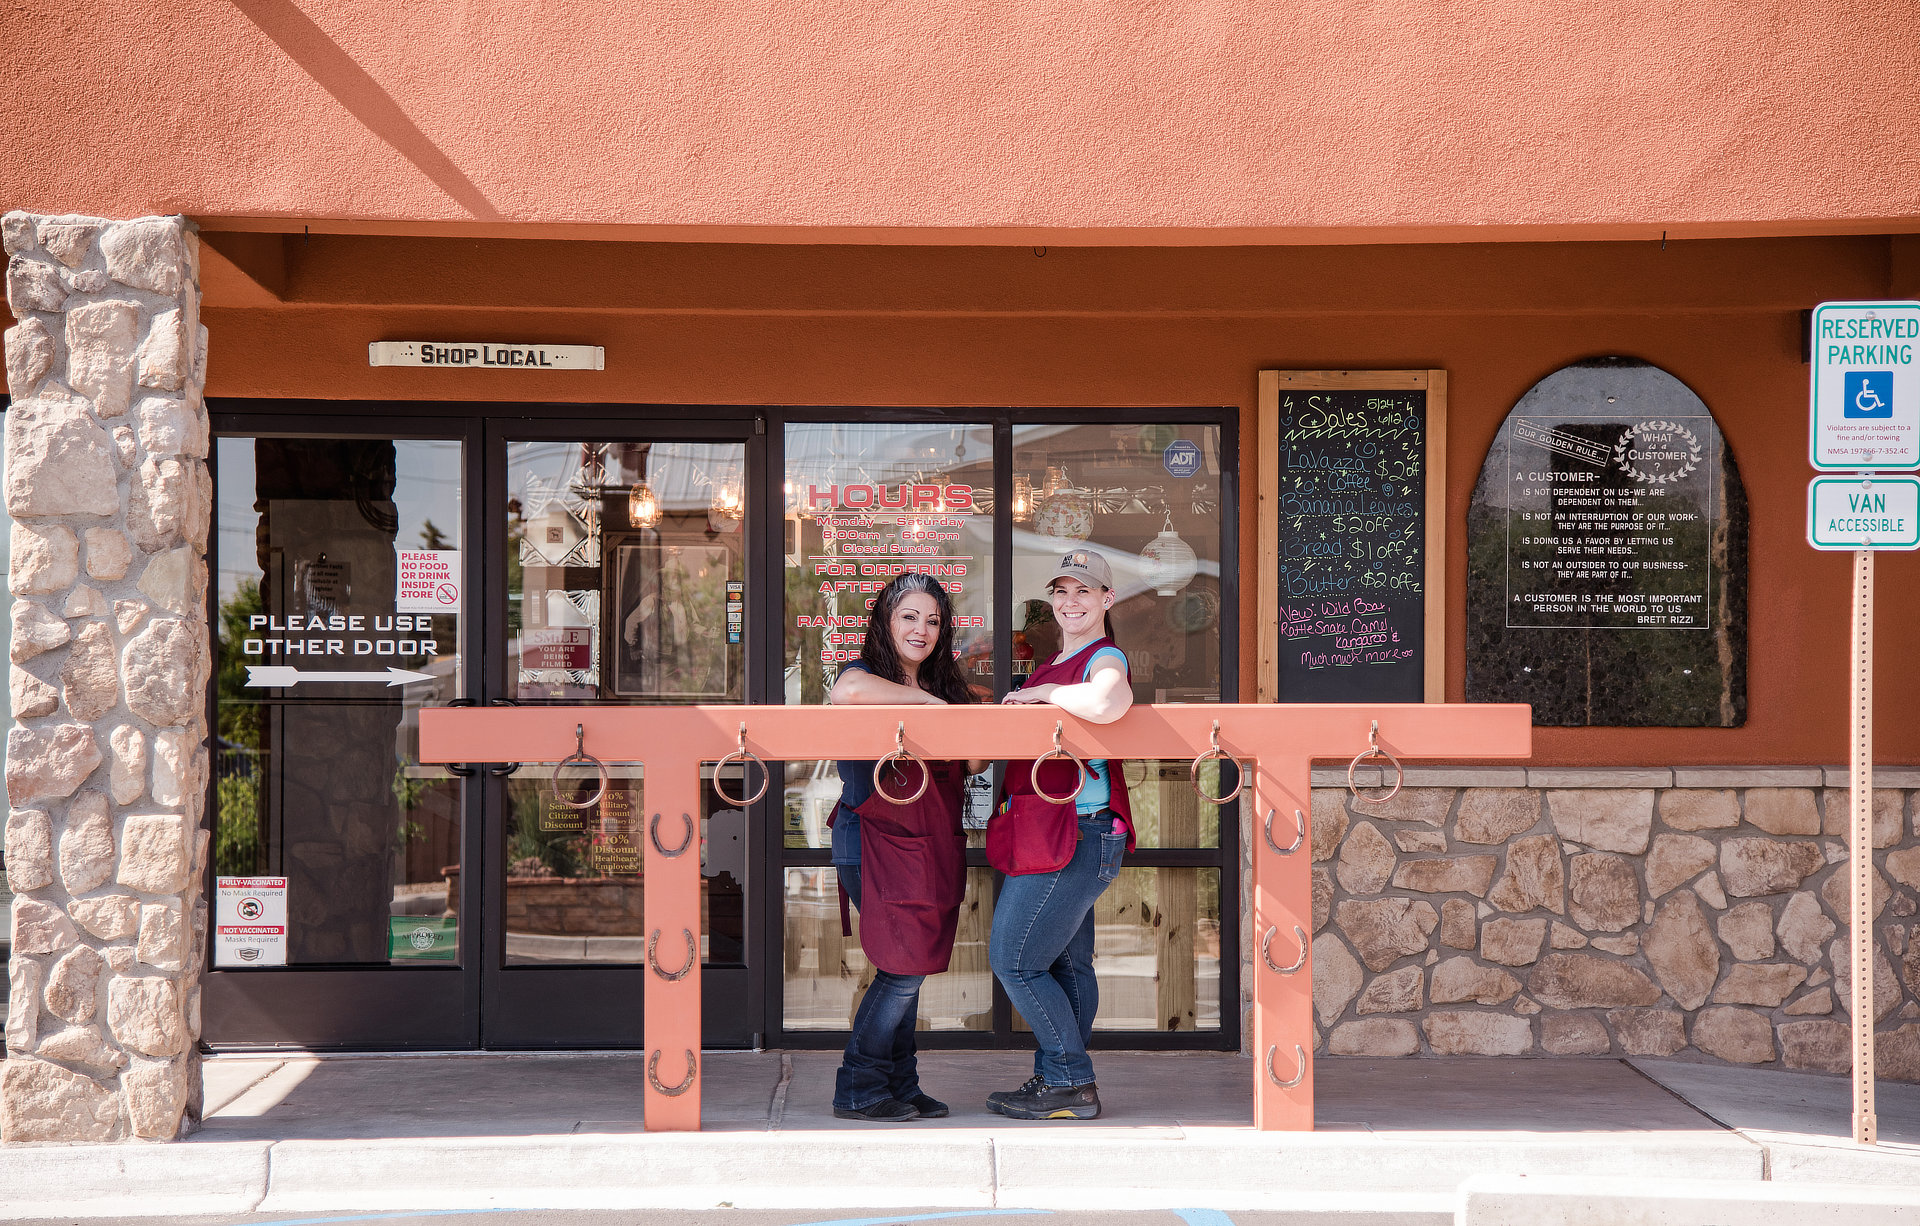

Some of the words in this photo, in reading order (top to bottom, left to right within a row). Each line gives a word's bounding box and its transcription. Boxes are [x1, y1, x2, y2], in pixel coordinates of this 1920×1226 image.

[1822, 318, 1919, 339] RESERVED
[421, 344, 479, 364] SHOP
[483, 345, 553, 366] LOCAL
[1828, 344, 1912, 365] PARKING
[1298, 395, 1368, 429] Sales
[1871, 424, 1896, 433] subject
[1517, 427, 1536, 439] OUR
[1539, 433, 1573, 451] GOLDEN
[1642, 433, 1673, 443] WHAT
[1851, 433, 1876, 442] and/or
[1876, 434, 1900, 442] towing
[1170, 452, 1194, 465] ADT
[1627, 449, 1687, 461] CUSTOMER
[1406, 461, 1420, 478] off
[1327, 471, 1373, 491] Coffee
[808, 484, 973, 509] HOURS
[1522, 488, 1531, 496] IS
[1534, 488, 1550, 496] NOT
[1553, 488, 1600, 496] DEPENDENT
[1603, 488, 1615, 496] ON
[1618, 488, 1646, 496] US-WE
[1649, 488, 1665, 496] ARE
[1281, 492, 1357, 516] Banana
[1360, 494, 1414, 518] Leaves
[1557, 498, 1601, 506] DEPENDENT
[1604, 498, 1615, 506] ON
[1618, 498, 1644, 506] THEM...
[1848, 493, 1886, 514] VAN
[816, 517, 875, 528] Monday
[896, 517, 965, 528] Saturday
[1522, 513, 1531, 521] IS
[1534, 513, 1552, 521] NOT
[1554, 513, 1566, 521] AN
[1569, 513, 1629, 521] INTERRUPTION
[1632, 513, 1644, 521] OF
[1647, 513, 1665, 521] OUR
[1668, 513, 1699, 521] WORK-
[1332, 515, 1363, 534] $2
[1557, 522, 1576, 531] THEY
[1577, 522, 1592, 531] ARE
[1594, 522, 1608, 531] THE
[1610, 522, 1644, 531] PURPOSE
[1646, 522, 1656, 531] OF
[1658, 522, 1671, 531] IT...
[1828, 518, 1905, 532] ACCESSIBLE
[822, 530, 881, 540] 8:00am
[901, 530, 961, 542] 6:00pm
[1522, 537, 1530, 545] IS
[1533, 537, 1559, 545] DOING
[1562, 537, 1574, 545] US
[1576, 537, 1582, 545] A
[1585, 537, 1610, 545] FAVOR
[1613, 537, 1624, 545] BY
[1627, 537, 1659, 545] LETTING
[1662, 537, 1674, 545] US
[842, 544, 887, 554] Closed
[890, 544, 939, 555] Sunday
[1284, 536, 1342, 558] Bread
[1349, 537, 1372, 560] $1
[1557, 547, 1581, 555] SERVE
[1584, 547, 1605, 555] THEIR
[1607, 547, 1639, 555] NEEDS...
[401, 553, 438, 561] PLEASE
[401, 562, 417, 570] NO
[419, 562, 448, 570] FOOD
[815, 563, 857, 576] FOR
[860, 563, 968, 576] ORDERING
[1521, 561, 1530, 569] IS
[1533, 561, 1549, 569] NOT
[1552, 561, 1563, 569] AN
[1566, 561, 1606, 569] OUTSIDER
[1608, 561, 1619, 569] TO
[1622, 561, 1640, 569] OUR
[1642, 561, 1688, 569] BUSINESS-
[401, 571, 416, 580] OR
[418, 571, 450, 580] DRINK
[1557, 571, 1574, 579] THEY
[1576, 571, 1590, 579] ARE
[1591, 571, 1607, 579] PART
[1609, 571, 1619, 579] OF
[1621, 571, 1633, 579] IT...
[401, 581, 435, 589] INSIDE
[1286, 569, 1357, 596] Butter
[1360, 569, 1387, 589] $2
[1390, 572, 1414, 590] off
[401, 590, 433, 598] STORE
[1513, 594, 1521, 603] A
[1524, 594, 1578, 603] CUSTOMER
[1581, 594, 1592, 603] IS
[1595, 594, 1614, 603] THE
[1618, 594, 1645, 603] MOST
[1649, 594, 1703, 603] IMPORTANT
[1321, 601, 1351, 616] Wild
[1533, 604, 1573, 613] PERSON
[1577, 604, 1587, 613] IN
[1590, 604, 1609, 613] THE
[1613, 604, 1647, 613] WORLD
[1650, 604, 1664, 613] TO
[1667, 604, 1682, 613] US
[250, 615, 365, 631] PLEASE
[375, 615, 432, 632] USE
[797, 615, 871, 628] RANCH
[1637, 615, 1667, 624] BRETT
[1670, 615, 1694, 624] RIZZI
[243, 639, 345, 655] OTHER
[354, 639, 439, 656] DOOR
[1335, 633, 1387, 656] Kangaroo
[1301, 651, 1331, 668] Much
[1331, 652, 1363, 665] much
[1365, 648, 1402, 662] more
[603, 791, 624, 801] 10%
[598, 801, 629, 810] Military
[548, 812, 579, 820] Citizen
[544, 821, 583, 829] Discount
[604, 834, 629, 845] 10%
[595, 845, 638, 853] Discount
[595, 863, 638, 871] Employees
